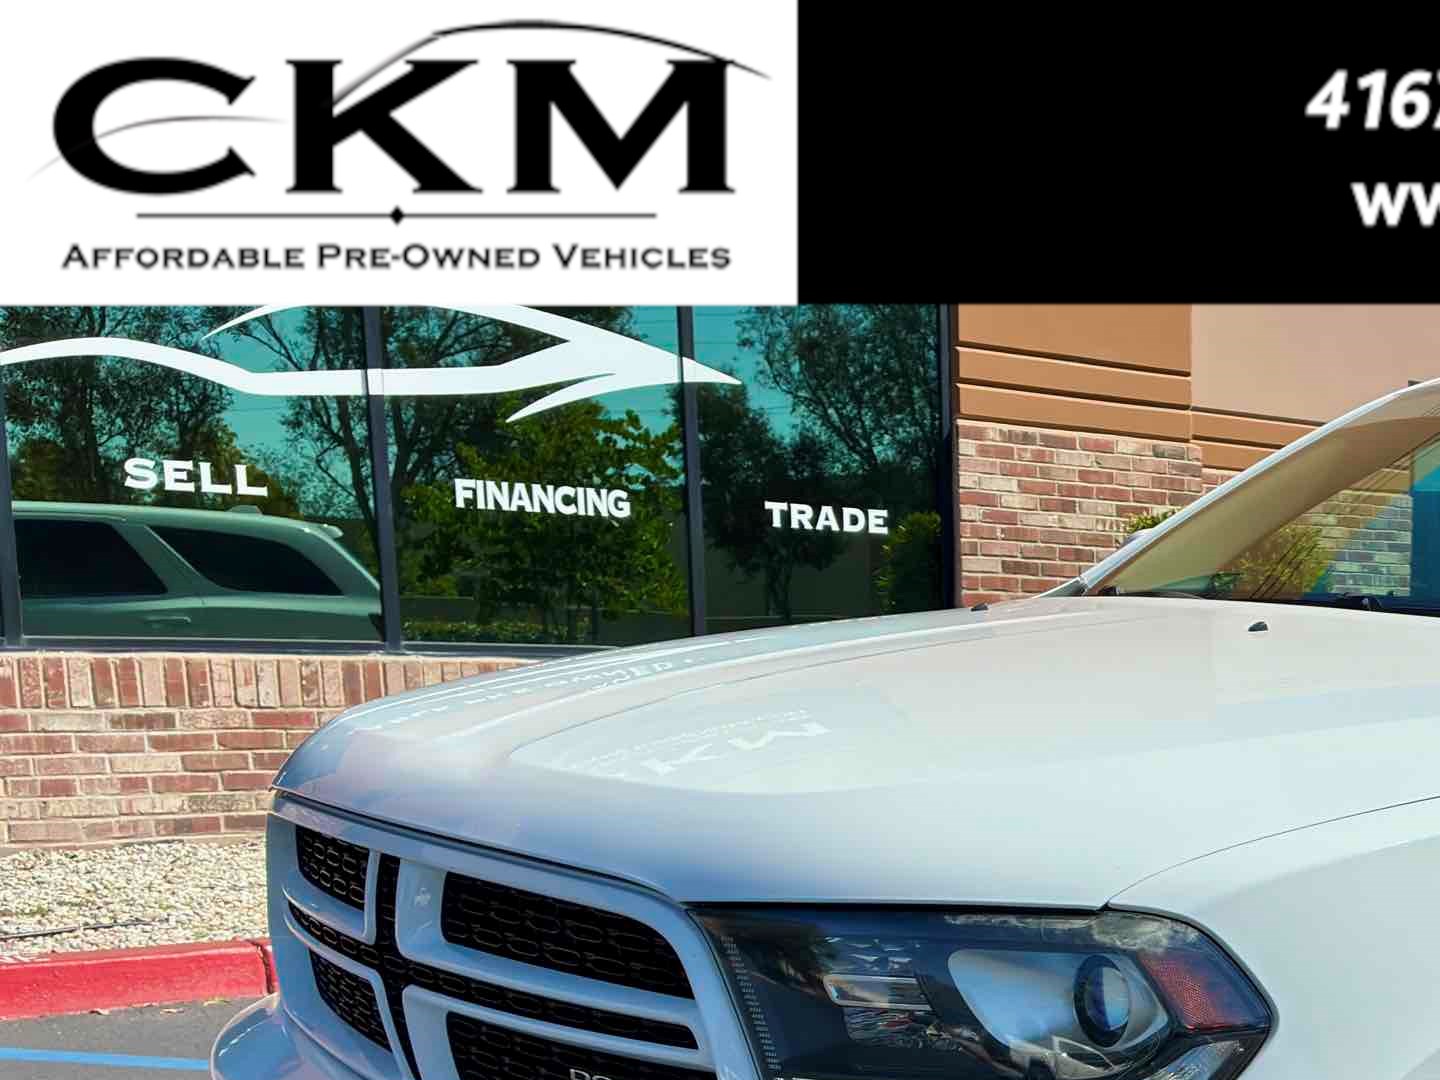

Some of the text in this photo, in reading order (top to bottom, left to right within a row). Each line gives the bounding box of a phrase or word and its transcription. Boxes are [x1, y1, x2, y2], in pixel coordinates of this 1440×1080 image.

[123, 456, 269, 497] SELL
[454, 478, 631, 518] FINANCING
[764, 500, 889, 535] TRADE
